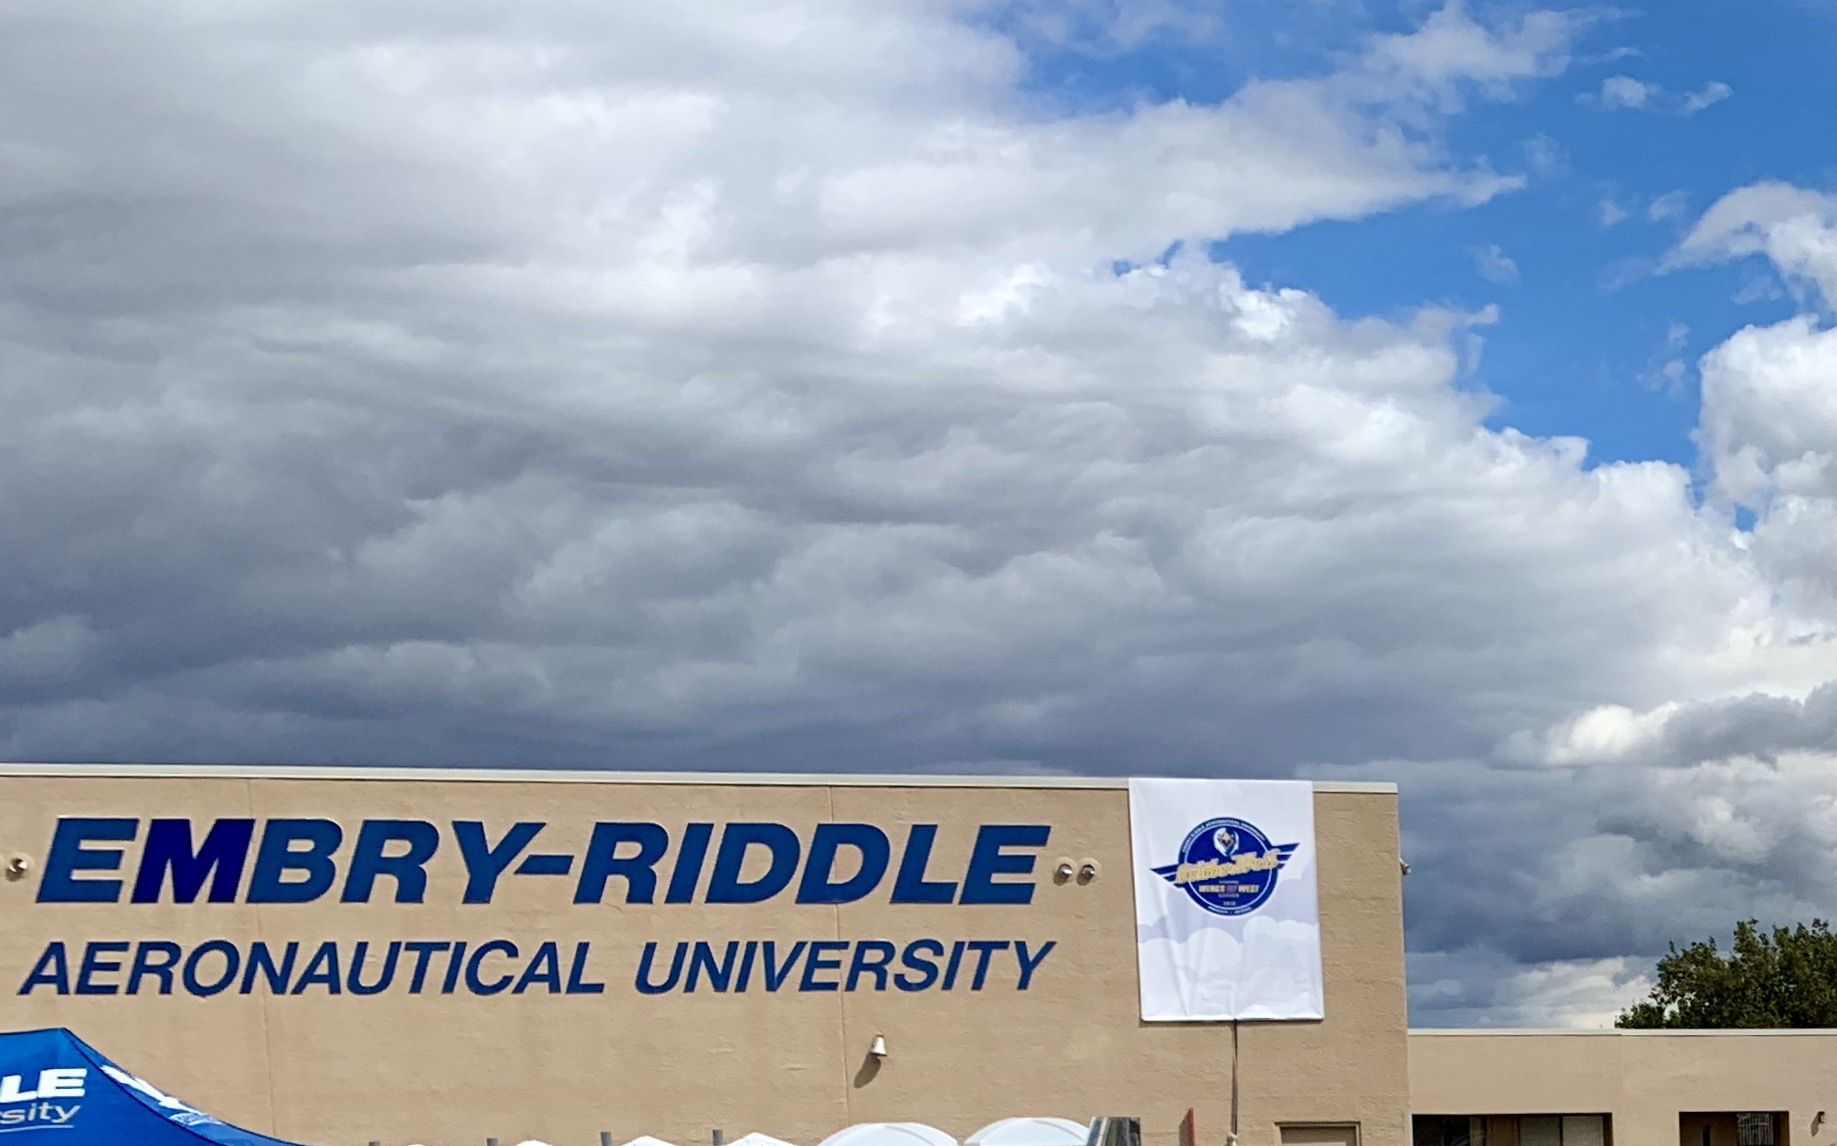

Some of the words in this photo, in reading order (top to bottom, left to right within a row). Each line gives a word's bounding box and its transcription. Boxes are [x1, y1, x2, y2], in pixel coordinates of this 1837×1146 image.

[36, 817, 1051, 905] EMBRY-RIDDLE
[18, 939, 606, 997] AERONAUTICAL
[633, 938, 1057, 995] UNIVERSITY
